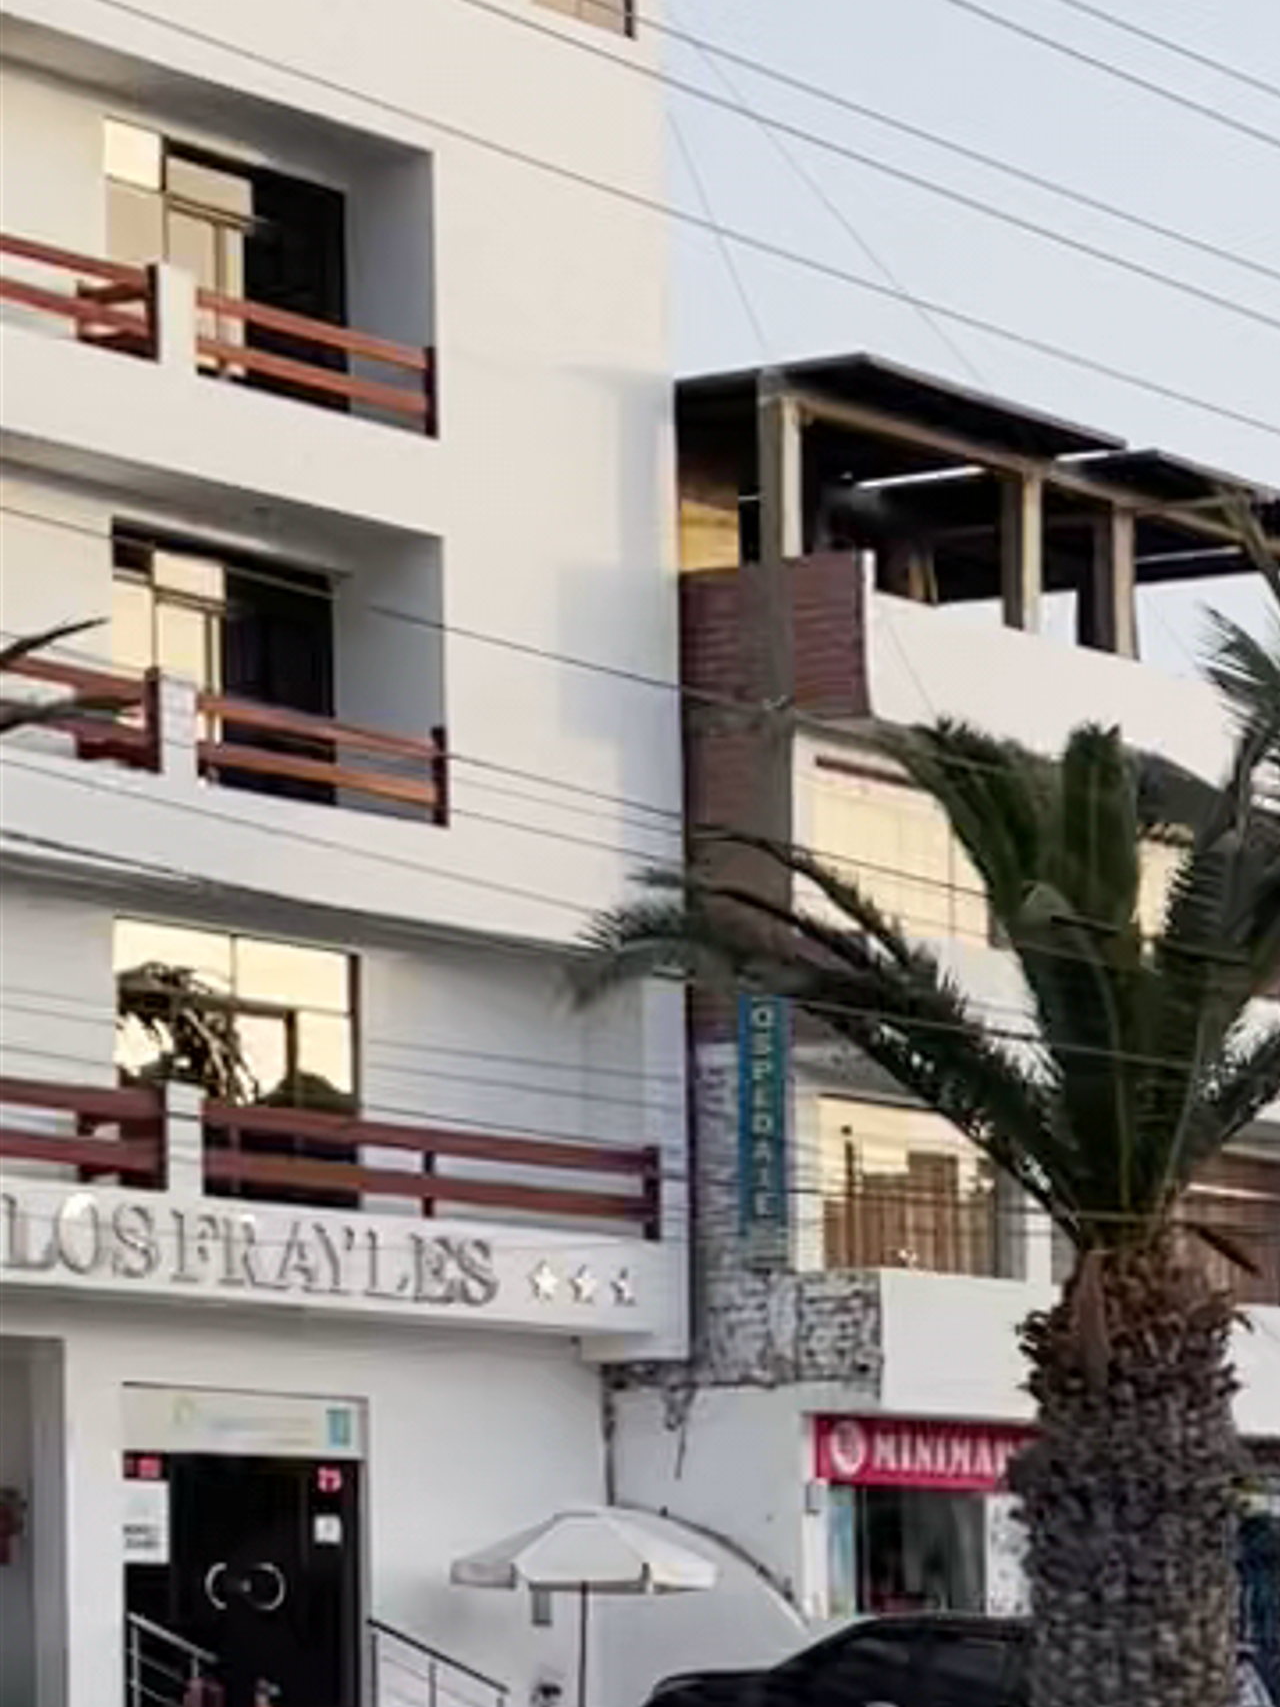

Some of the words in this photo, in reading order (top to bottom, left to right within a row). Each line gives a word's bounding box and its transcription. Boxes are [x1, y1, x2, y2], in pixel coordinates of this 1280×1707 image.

[751, 996, 775, 1219] OSPEDAJE
[2, 1193, 156, 1277] LOS
[170, 1207, 499, 1306] FRAYLES
[873, 1430, 1016, 1477] MINIMAR
